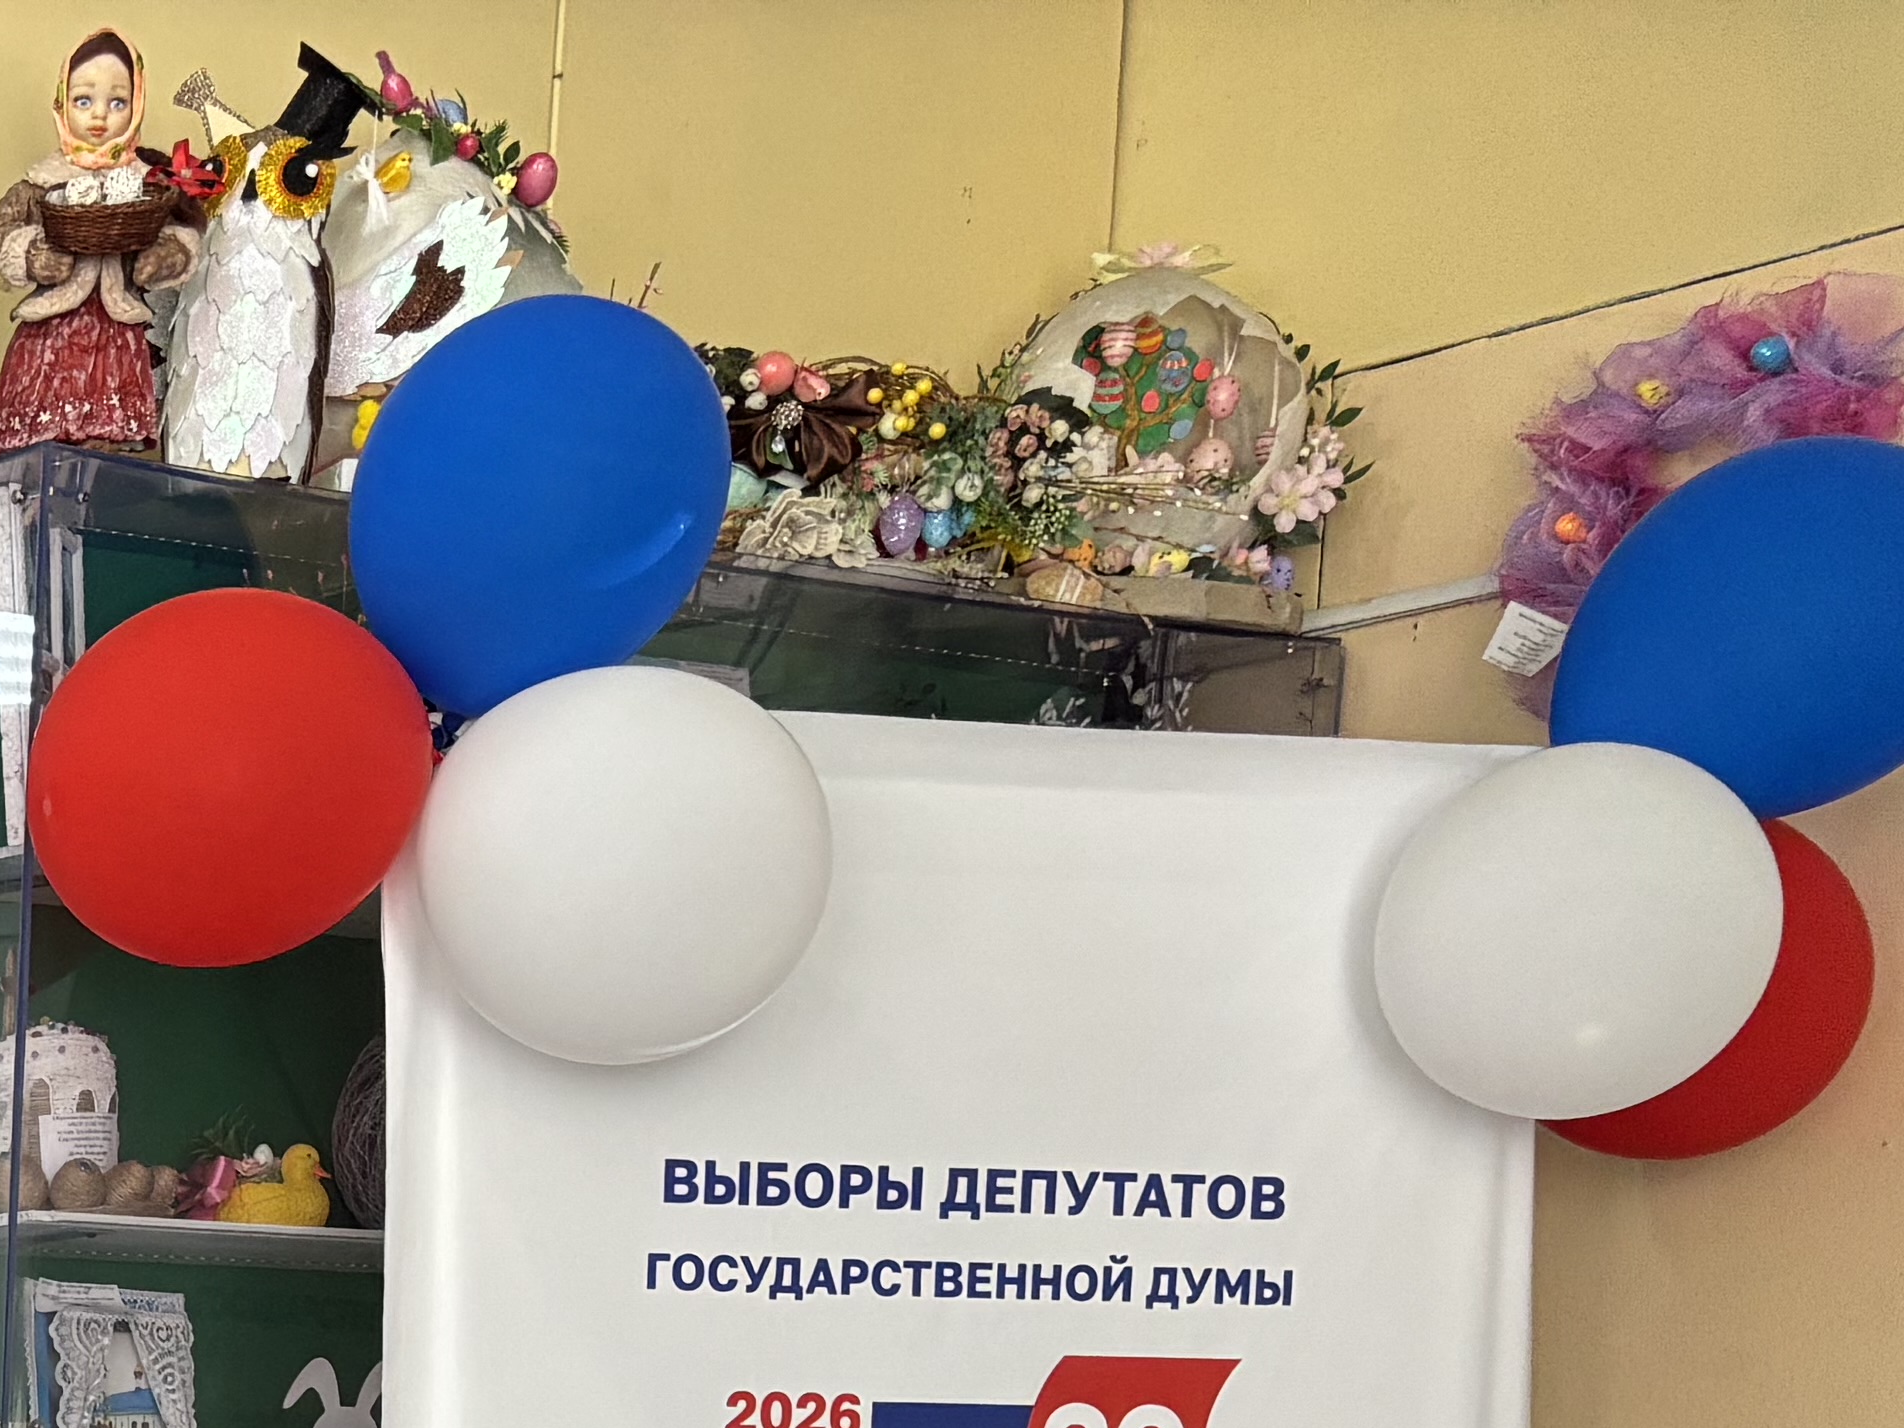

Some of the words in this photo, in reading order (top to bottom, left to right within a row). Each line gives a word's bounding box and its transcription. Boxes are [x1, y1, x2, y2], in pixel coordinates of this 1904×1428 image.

[663, 1159, 924, 1210] ВЫБОРЫ
[939, 1168, 1286, 1220] ДЕПУТАТОВ
[646, 1254, 1133, 1301] ГОСУДАРСТВЕННОЙ
[1145, 1267, 1294, 1309] ДУМЫ
